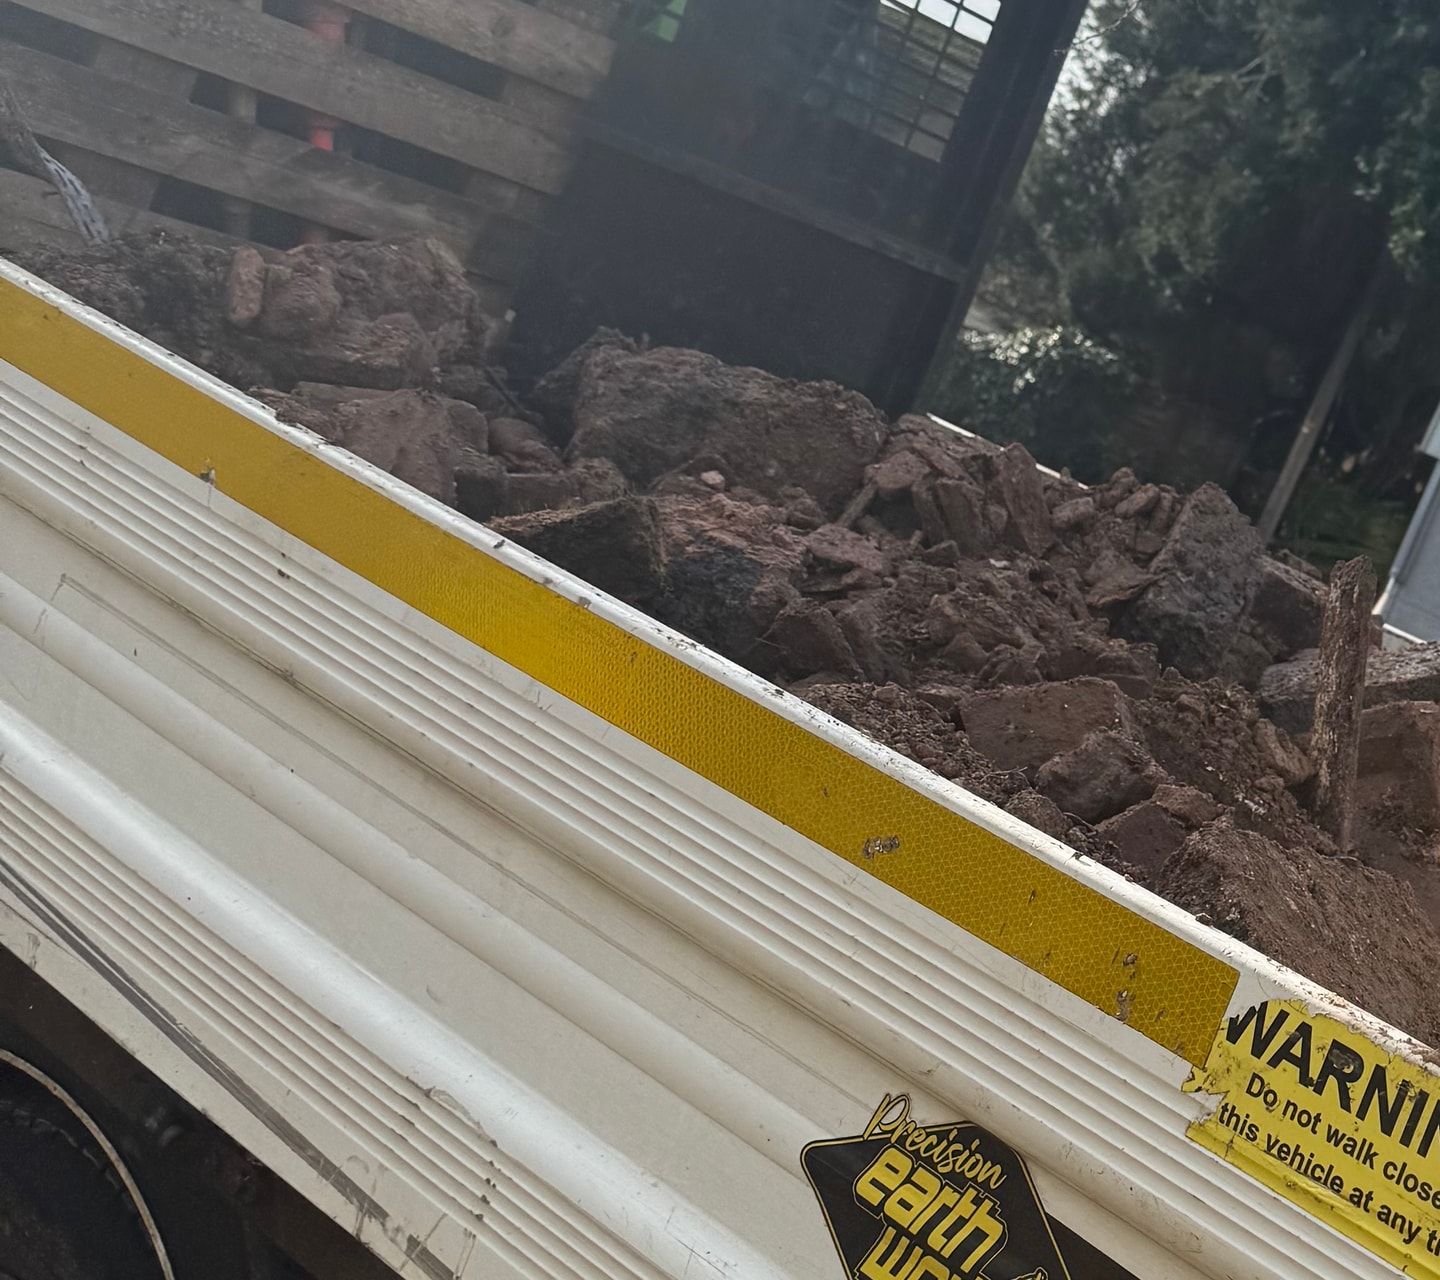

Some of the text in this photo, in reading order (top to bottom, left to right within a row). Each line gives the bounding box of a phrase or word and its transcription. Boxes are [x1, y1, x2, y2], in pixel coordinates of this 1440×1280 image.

[864, 1093, 1007, 1189] Precision
[1218, 1101, 1259, 1146] this
[1264, 1133, 1345, 1196] vehicle
[1348, 1186, 1374, 1213] at
[1376, 1200, 1422, 1247] any
[1246, 1074, 1279, 1111] Do
[1282, 1098, 1323, 1134] not
[1326, 1119, 1377, 1178] walk
[856, 1147, 1004, 1273] earth
